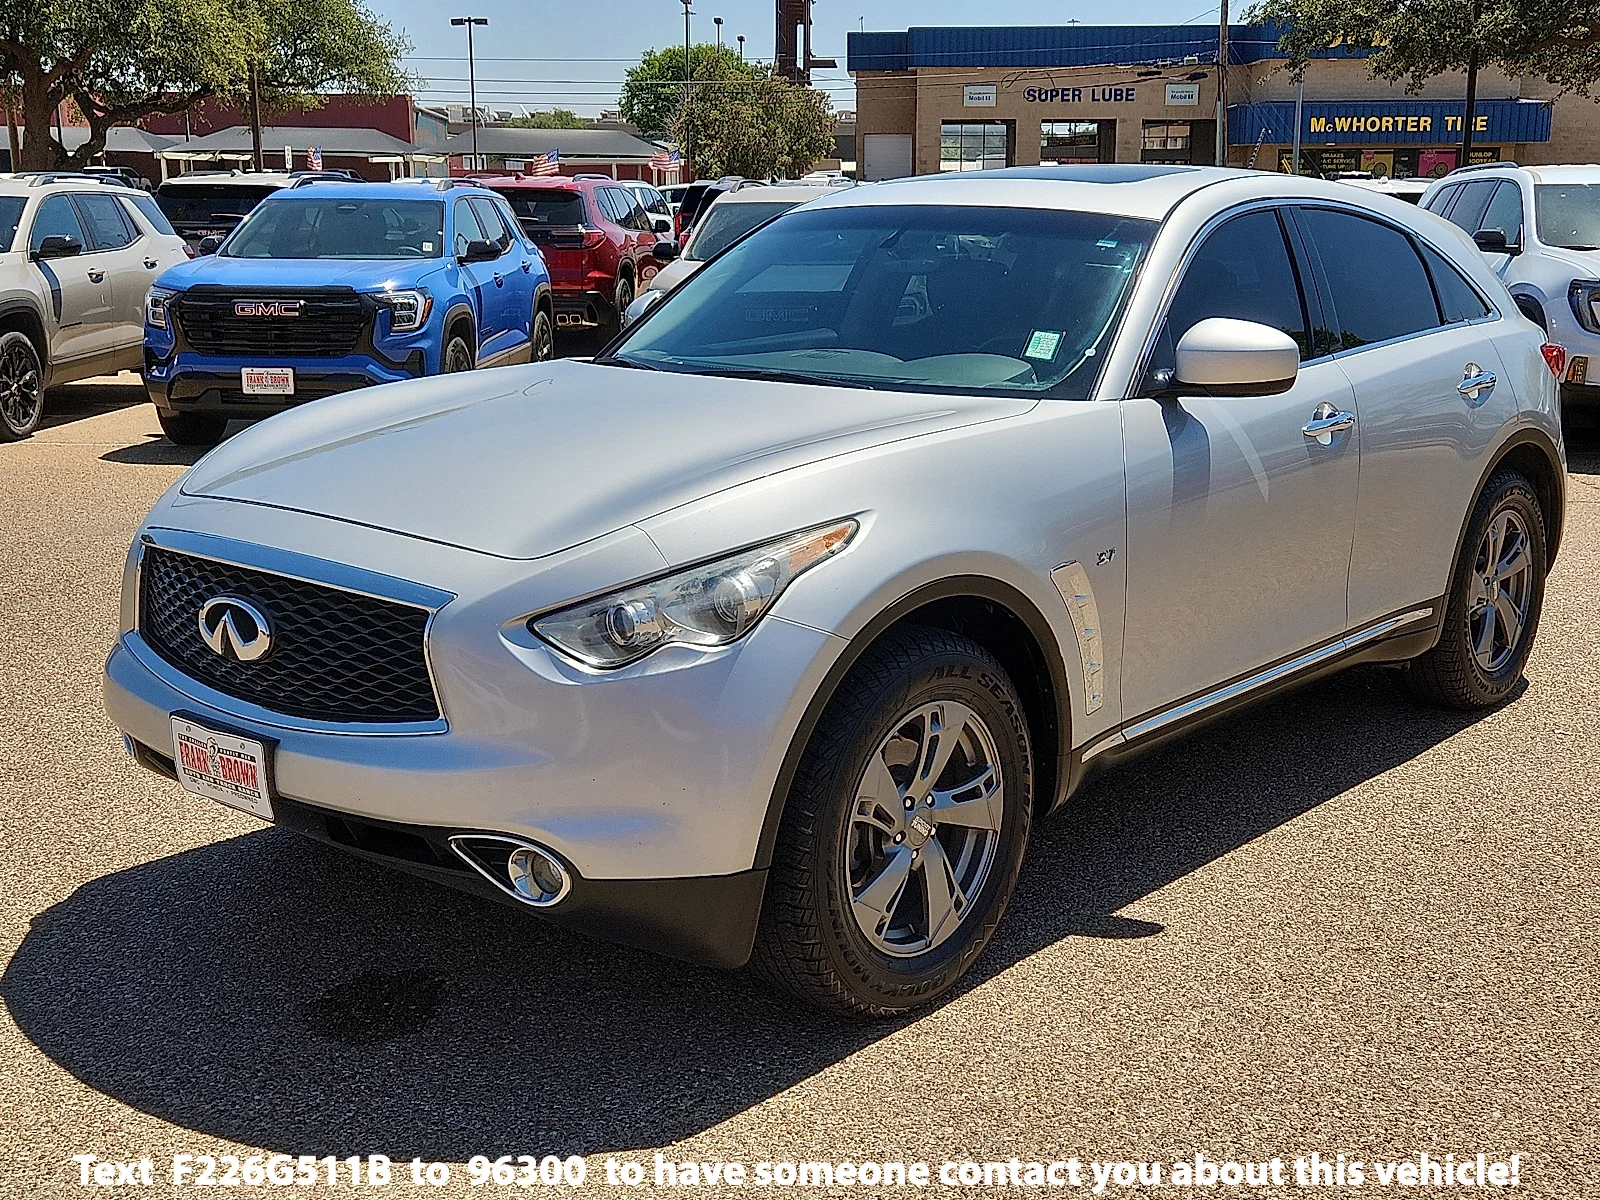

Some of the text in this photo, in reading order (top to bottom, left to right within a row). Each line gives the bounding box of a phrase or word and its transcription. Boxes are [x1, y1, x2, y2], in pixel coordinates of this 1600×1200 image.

[1026, 87, 1135, 103] SUPER LUBE
[1310, 116, 1488, 133] McWHORTER TIE
[235, 302, 300, 316] GMC
[976, 672, 1031, 776] SEASON
[178, 741, 259, 790] FRANK BROWN
